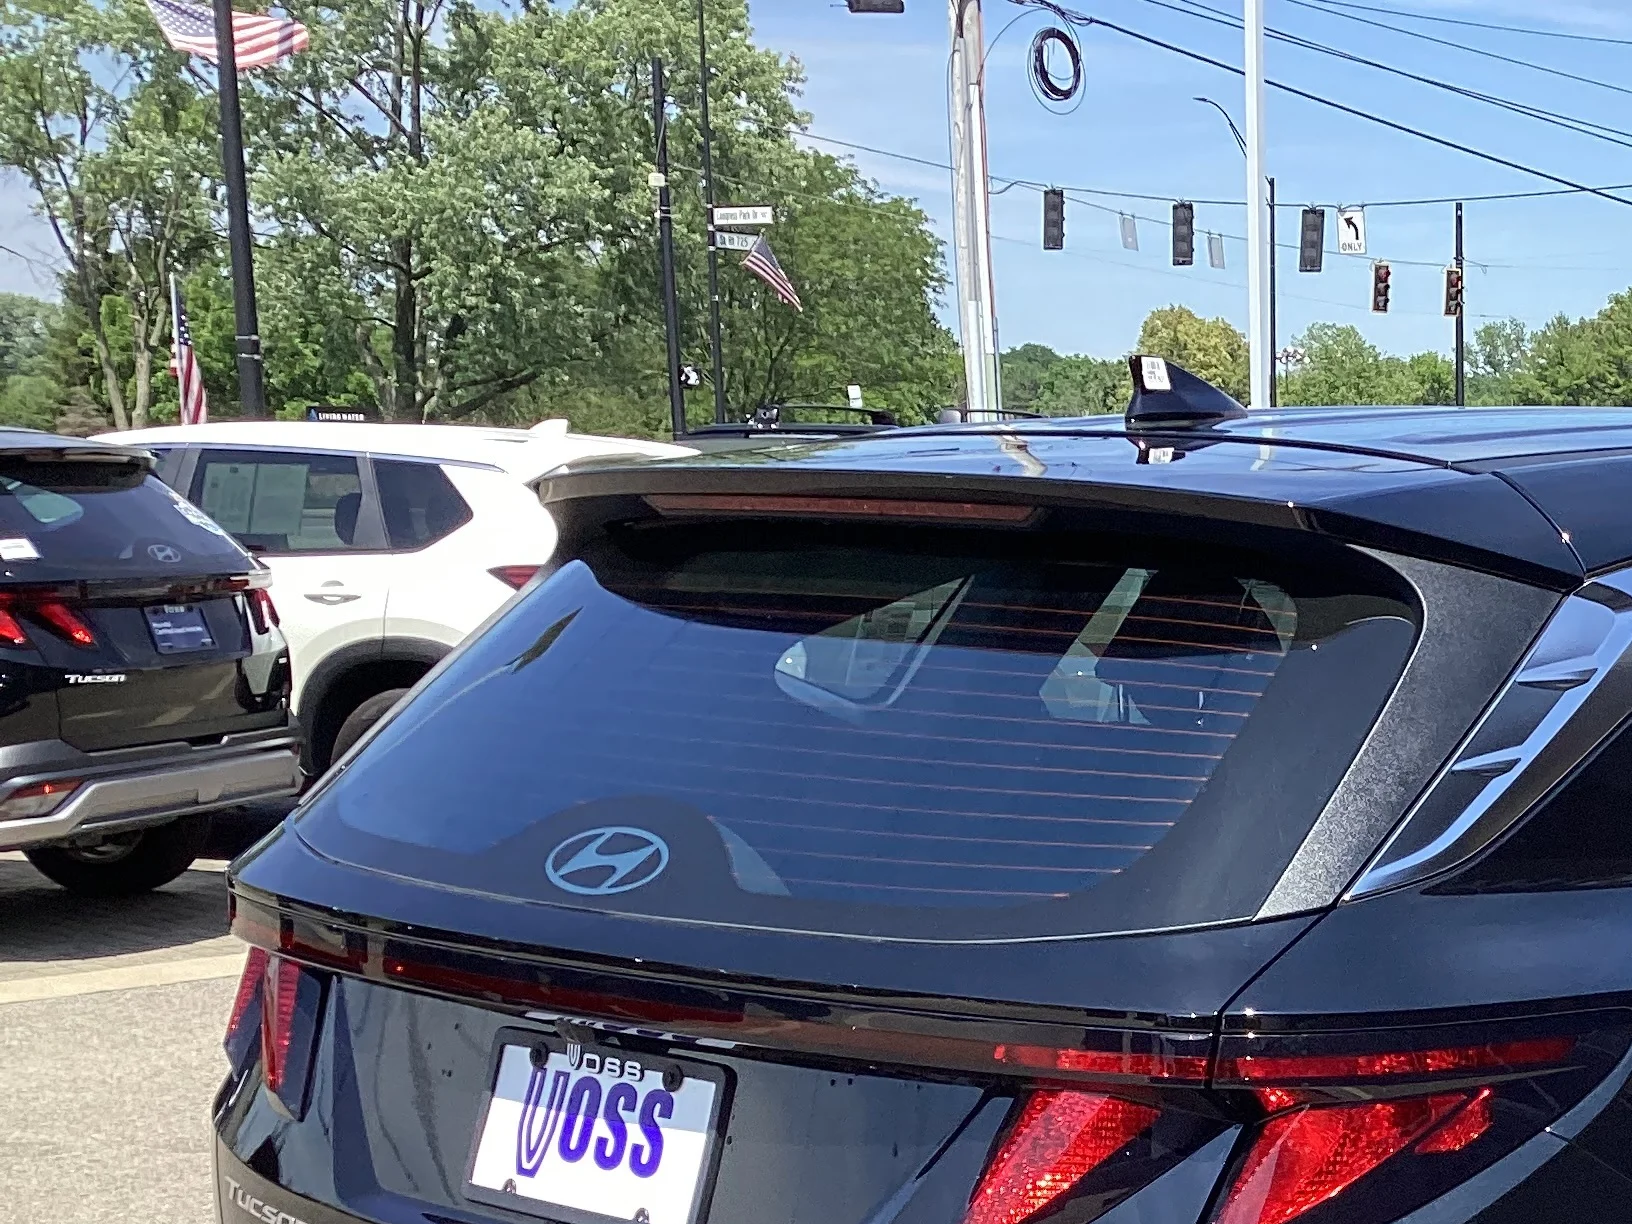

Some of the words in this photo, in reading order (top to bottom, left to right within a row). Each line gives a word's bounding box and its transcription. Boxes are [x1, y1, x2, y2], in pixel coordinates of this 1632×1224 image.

[1341, 242, 1362, 252] ONLY
[566, 1042, 644, 1082] VOSS
[515, 1067, 675, 1179] VOSS
